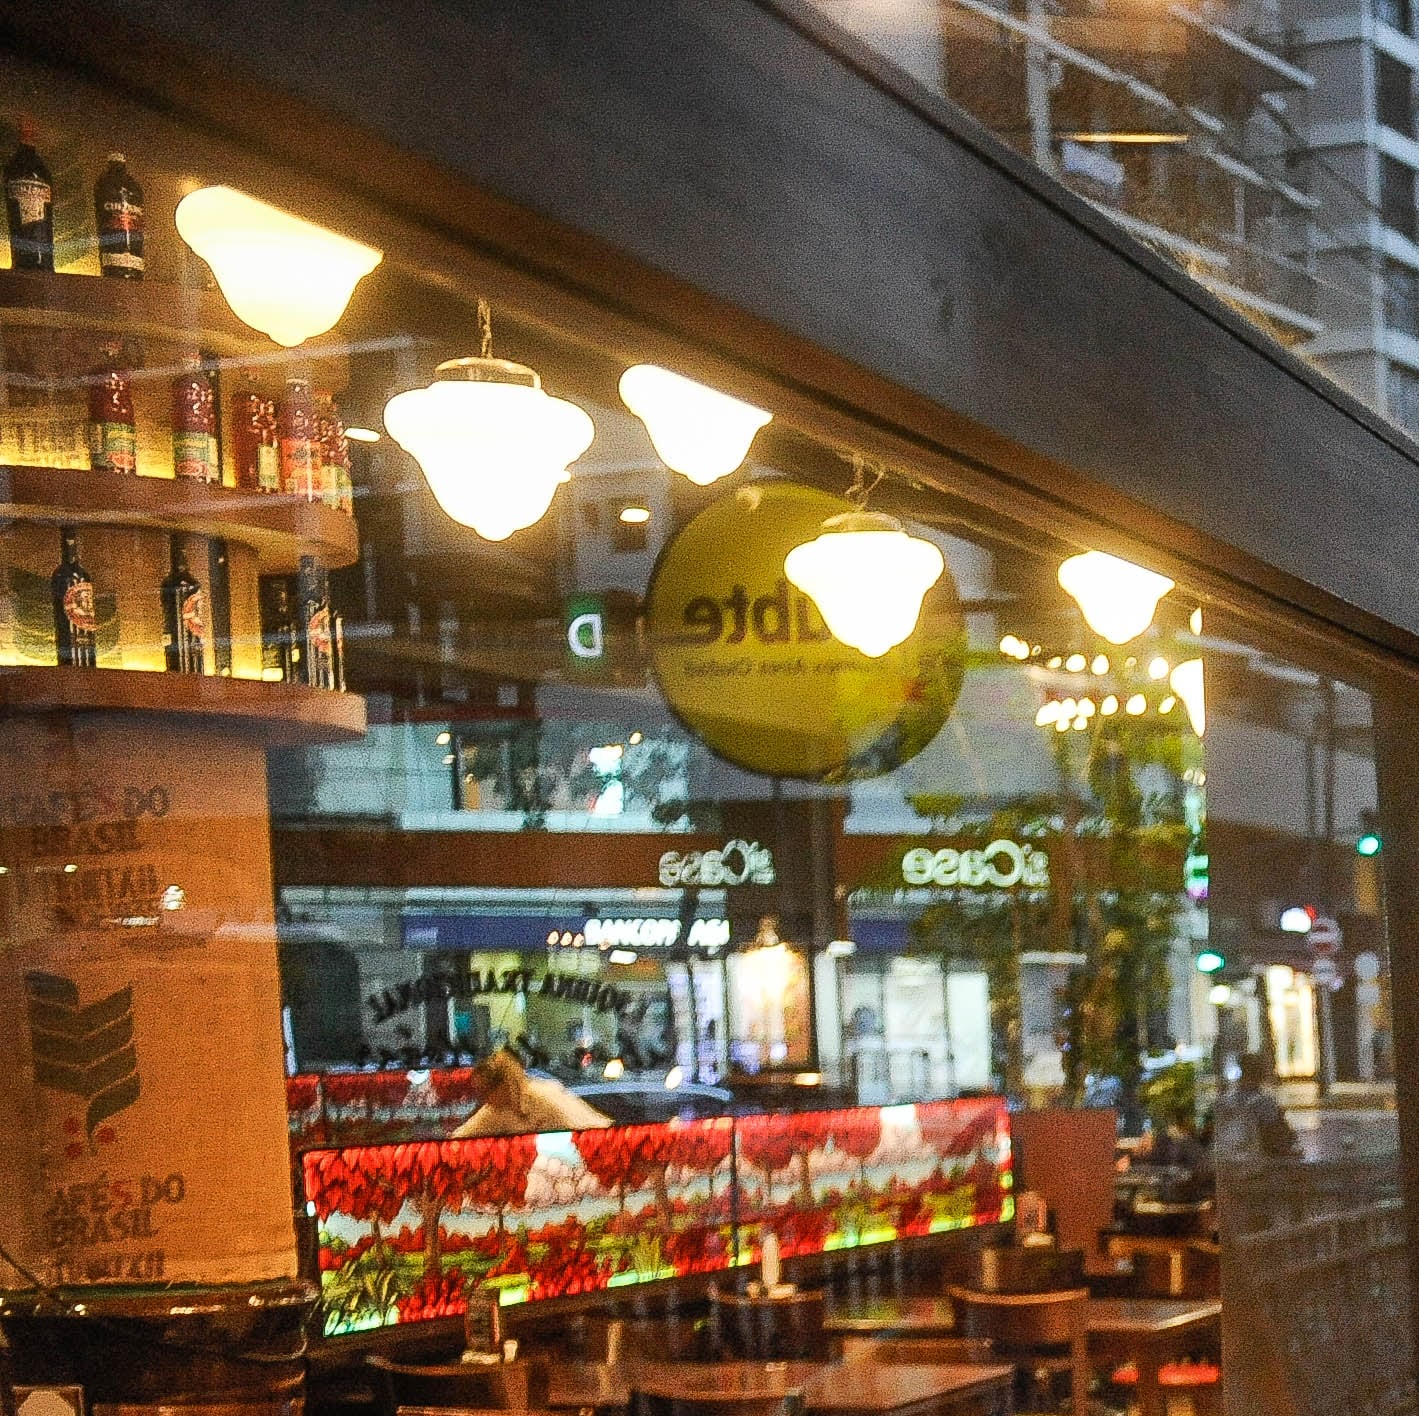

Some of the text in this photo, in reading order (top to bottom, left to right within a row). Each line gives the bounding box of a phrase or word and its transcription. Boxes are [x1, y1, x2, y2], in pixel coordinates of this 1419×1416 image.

[44, 1171, 186, 1218] AFÉS DO
[49, 1208, 159, 1249] BRASIL
